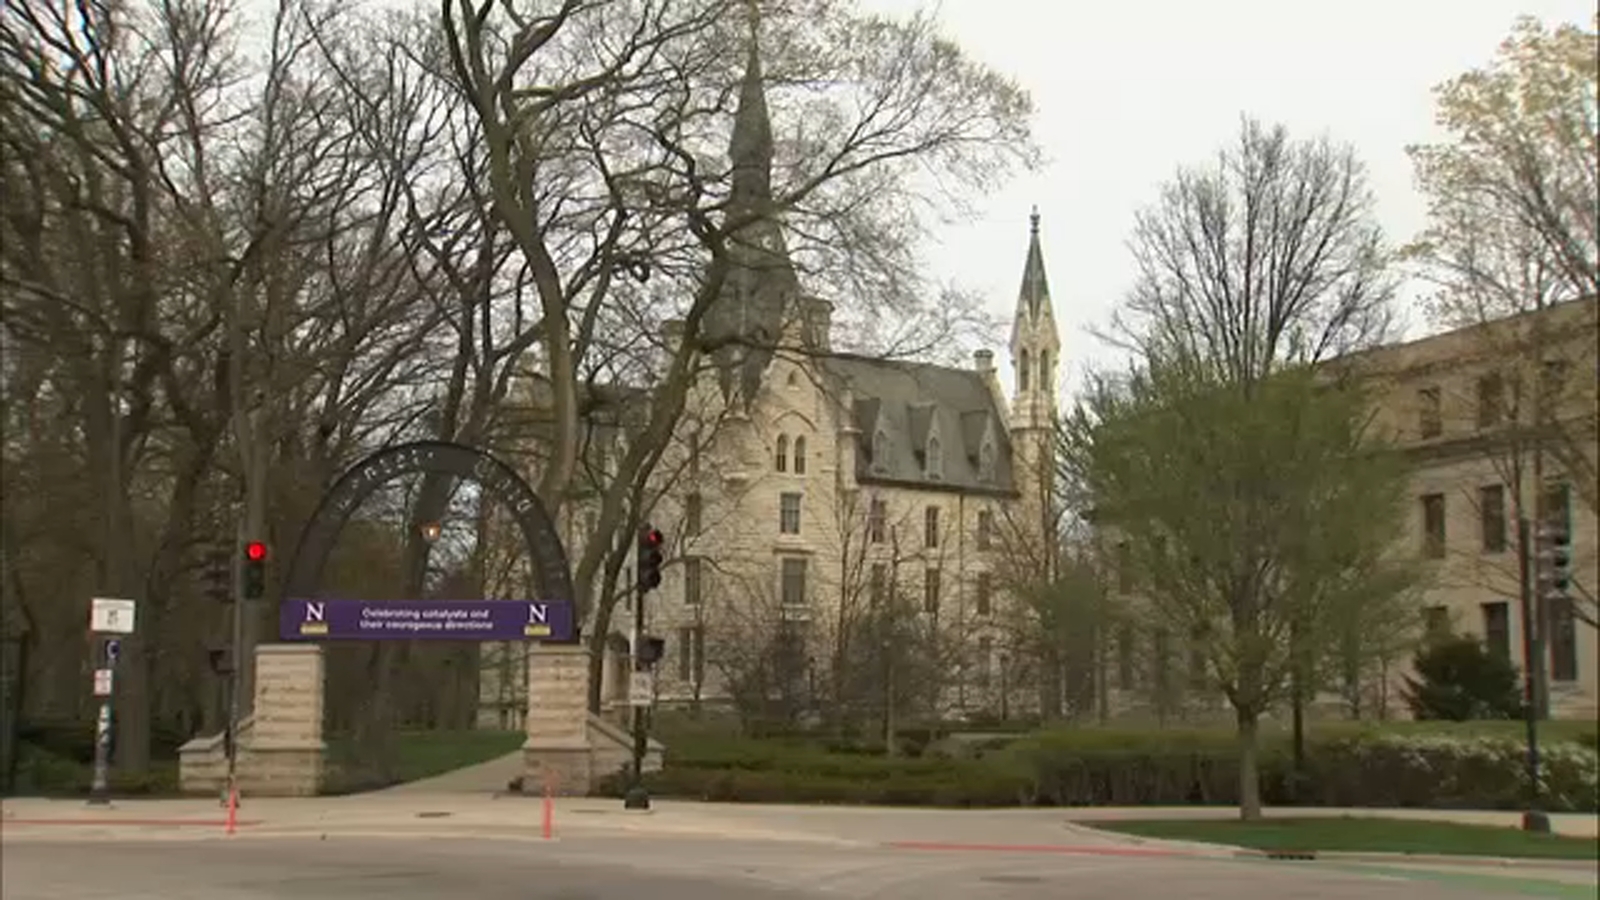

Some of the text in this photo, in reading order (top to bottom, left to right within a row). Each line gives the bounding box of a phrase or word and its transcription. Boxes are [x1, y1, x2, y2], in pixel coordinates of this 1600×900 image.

[306, 601, 326, 621] N
[362, 607, 420, 620] Celebrating
[470, 609, 489, 619] and
[528, 603, 548, 623] N
[359, 619, 383, 629] their
[445, 620, 493, 630] directions
